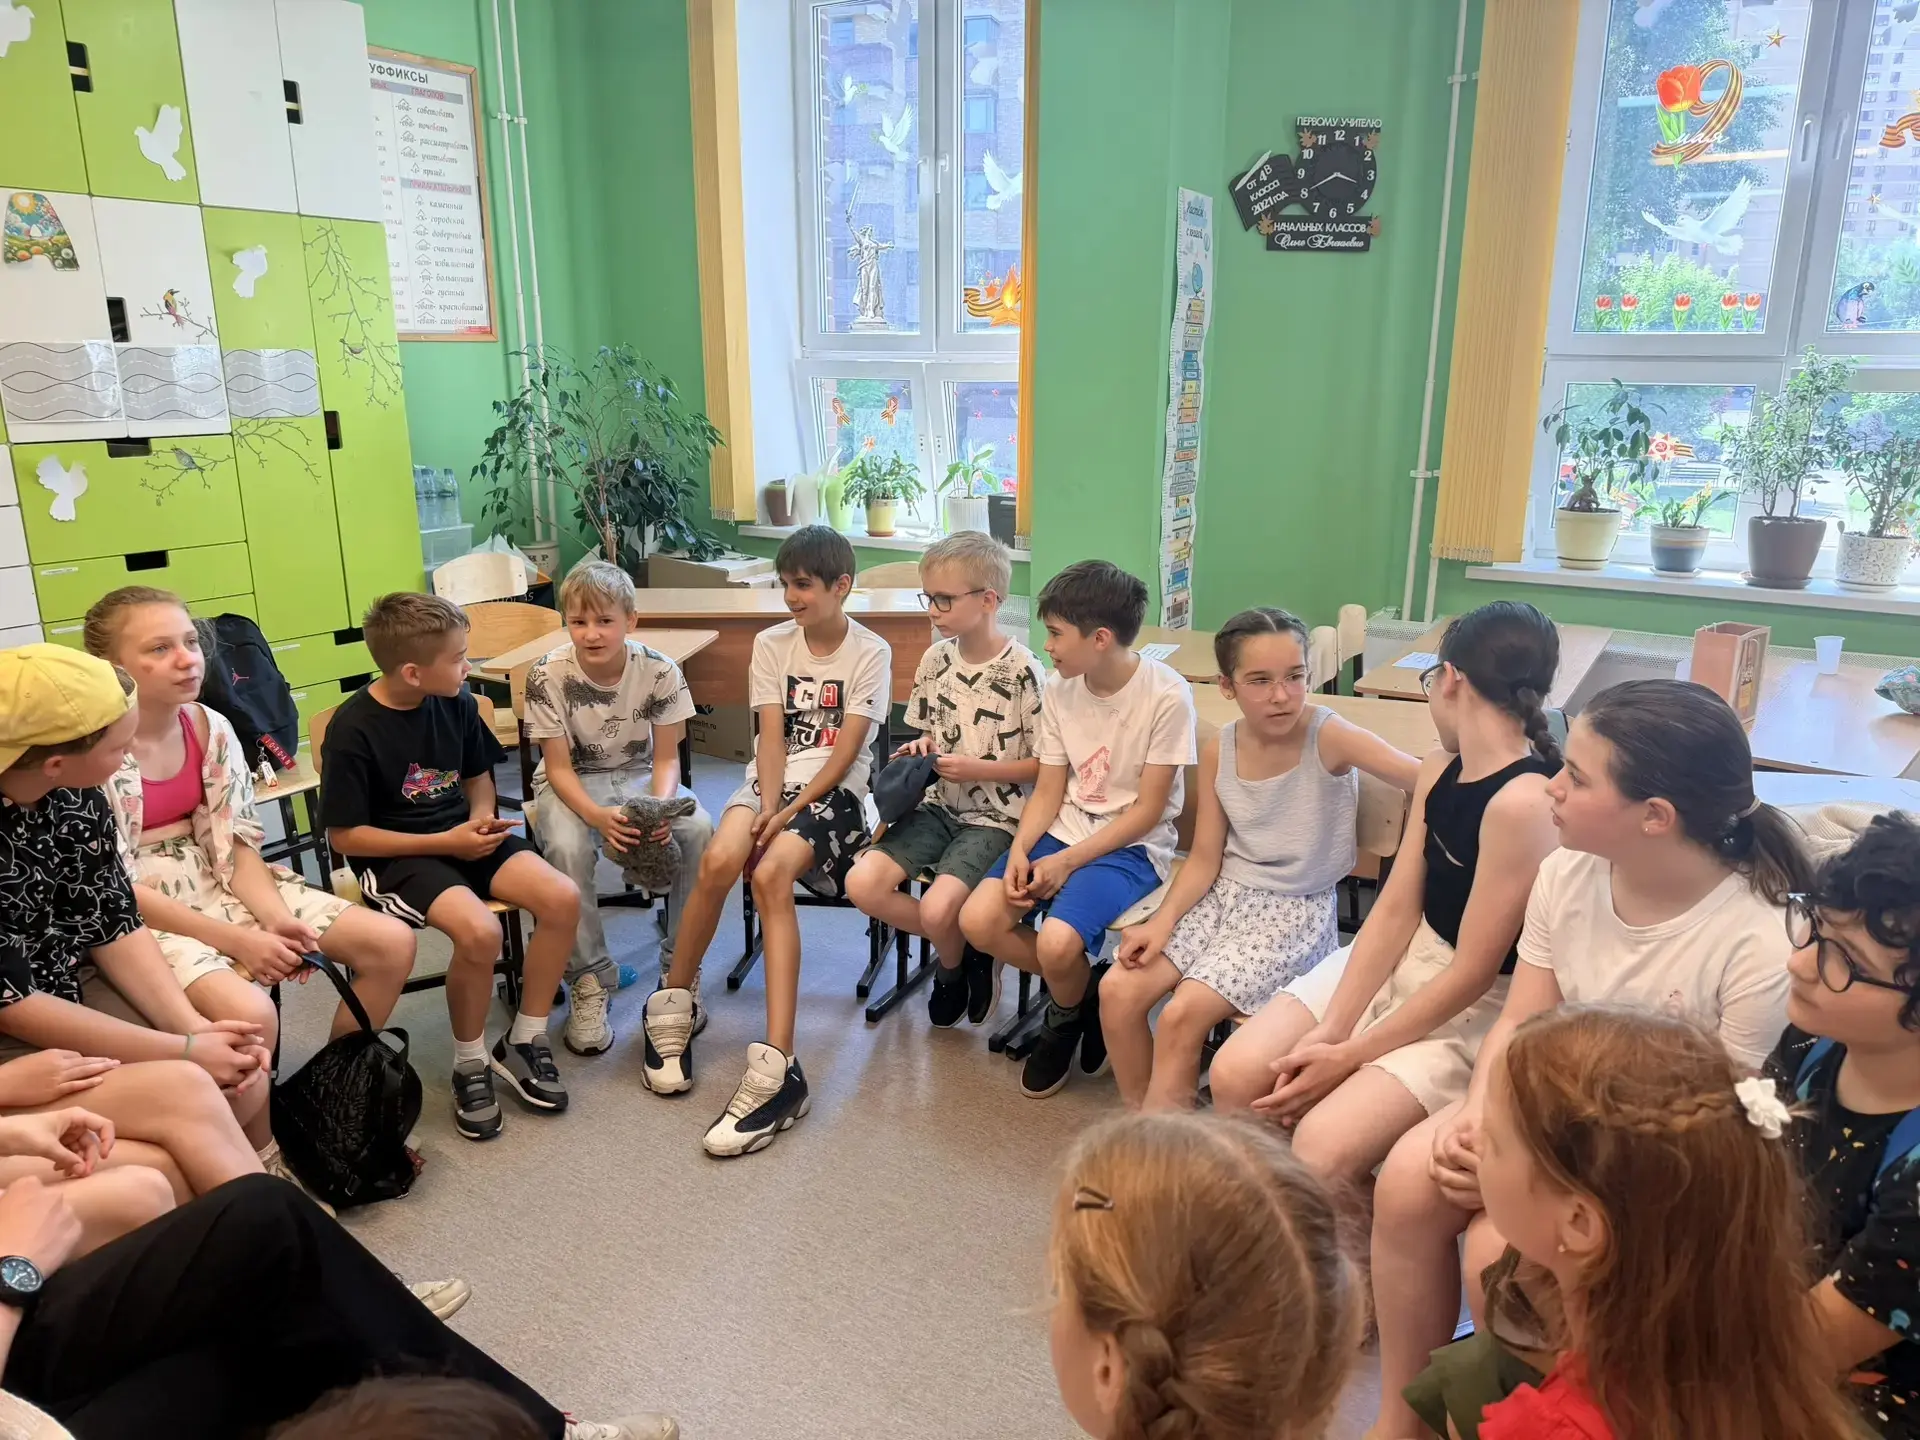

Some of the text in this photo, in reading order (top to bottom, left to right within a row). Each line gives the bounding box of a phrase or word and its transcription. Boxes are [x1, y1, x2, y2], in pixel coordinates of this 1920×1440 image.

[368, 62, 429, 84] УФФИКСЫ
[1297, 116, 1383, 128] ПЕРВОМУ УЧИТЕЛЮ
[1317, 134, 1327, 146] 11
[1333, 130, 1346, 141] 12
[1354, 135, 1360, 147] 1
[1301, 149, 1314, 160] 10
[1364, 150, 1372, 161] 2
[1297, 168, 1306, 179] 9
[1367, 170, 1375, 181] 3
[1300, 188, 1309, 199] 8
[1360, 189, 1369, 200] 4
[1312, 202, 1320, 213] 7
[1329, 207, 1337, 219] 6
[1346, 203, 1355, 214] 5
[430, 216, 465, 226] городской
[1273, 221, 1367, 233] НАЧАЛЬНЫХ КЛАССОВ
